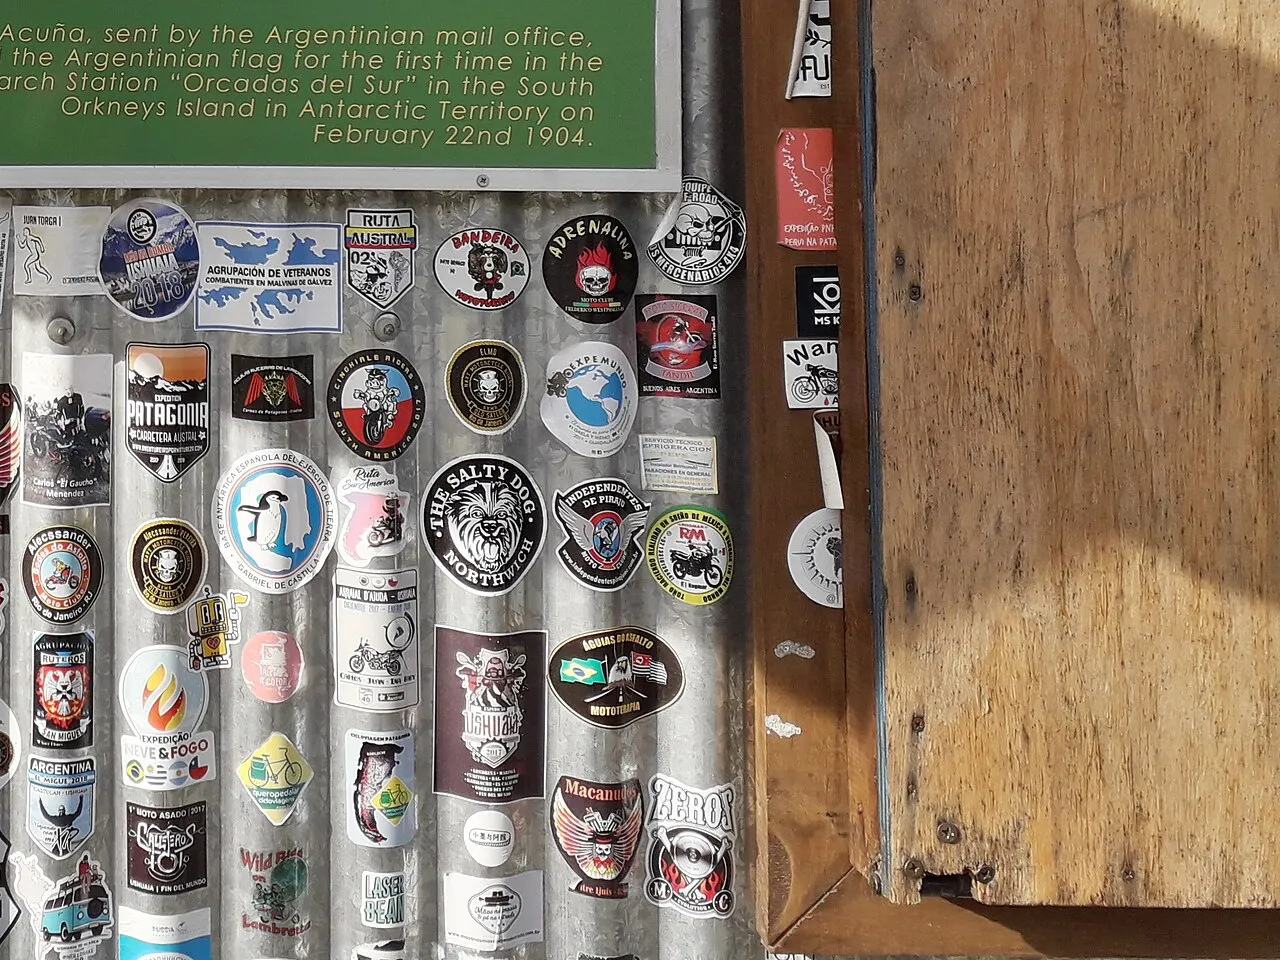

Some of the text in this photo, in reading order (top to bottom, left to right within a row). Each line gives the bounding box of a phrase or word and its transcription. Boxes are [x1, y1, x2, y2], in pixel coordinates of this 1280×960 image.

[103, 24, 159, 43] sent
[169, 24, 200, 47] by
[213, 24, 254, 44] the
[265, 25, 424, 49] Argentinian
[435, 26, 494, 46] mail
[504, 26, 594, 48] office,
[12, 47, 54, 66] the
[64, 48, 220, 71] Argentinian
[231, 48, 283, 74] flag
[294, 49, 331, 70] for
[341, 50, 384, 70] the
[395, 50, 444, 71] first
[454, 51, 513, 71] time
[524, 51, 547, 72] in
[559, 51, 604, 72] the
[66, 71, 159, 93] Station
[310, 75, 353, 95] del
[427, 75, 450, 96] in
[462, 76, 506, 96] the
[517, 76, 595, 97] South
[61, 96, 594, 125] Orkneys Island in Antarctic Territory on
[313, 124, 594, 149] February 22nd 1904.
[362, 214, 401, 228] RUTA
[350, 232, 411, 246] AUSTRAL
[548, 219, 633, 261] ADRENALINA
[207, 264, 332, 278] AGRUPACIÓN DE VETERANOS
[656, 254, 727, 282] MERCENARIOS
[128, 401, 208, 427] PATAGONIA
[430, 463, 537, 531] THE SALTY DOG
[566, 484, 644, 512] INDEPENDENTES
[441, 537, 534, 588] NORTHWICH
[170, 738, 209, 760] FOGO
[31, 760, 92, 775] ARGENTINA
